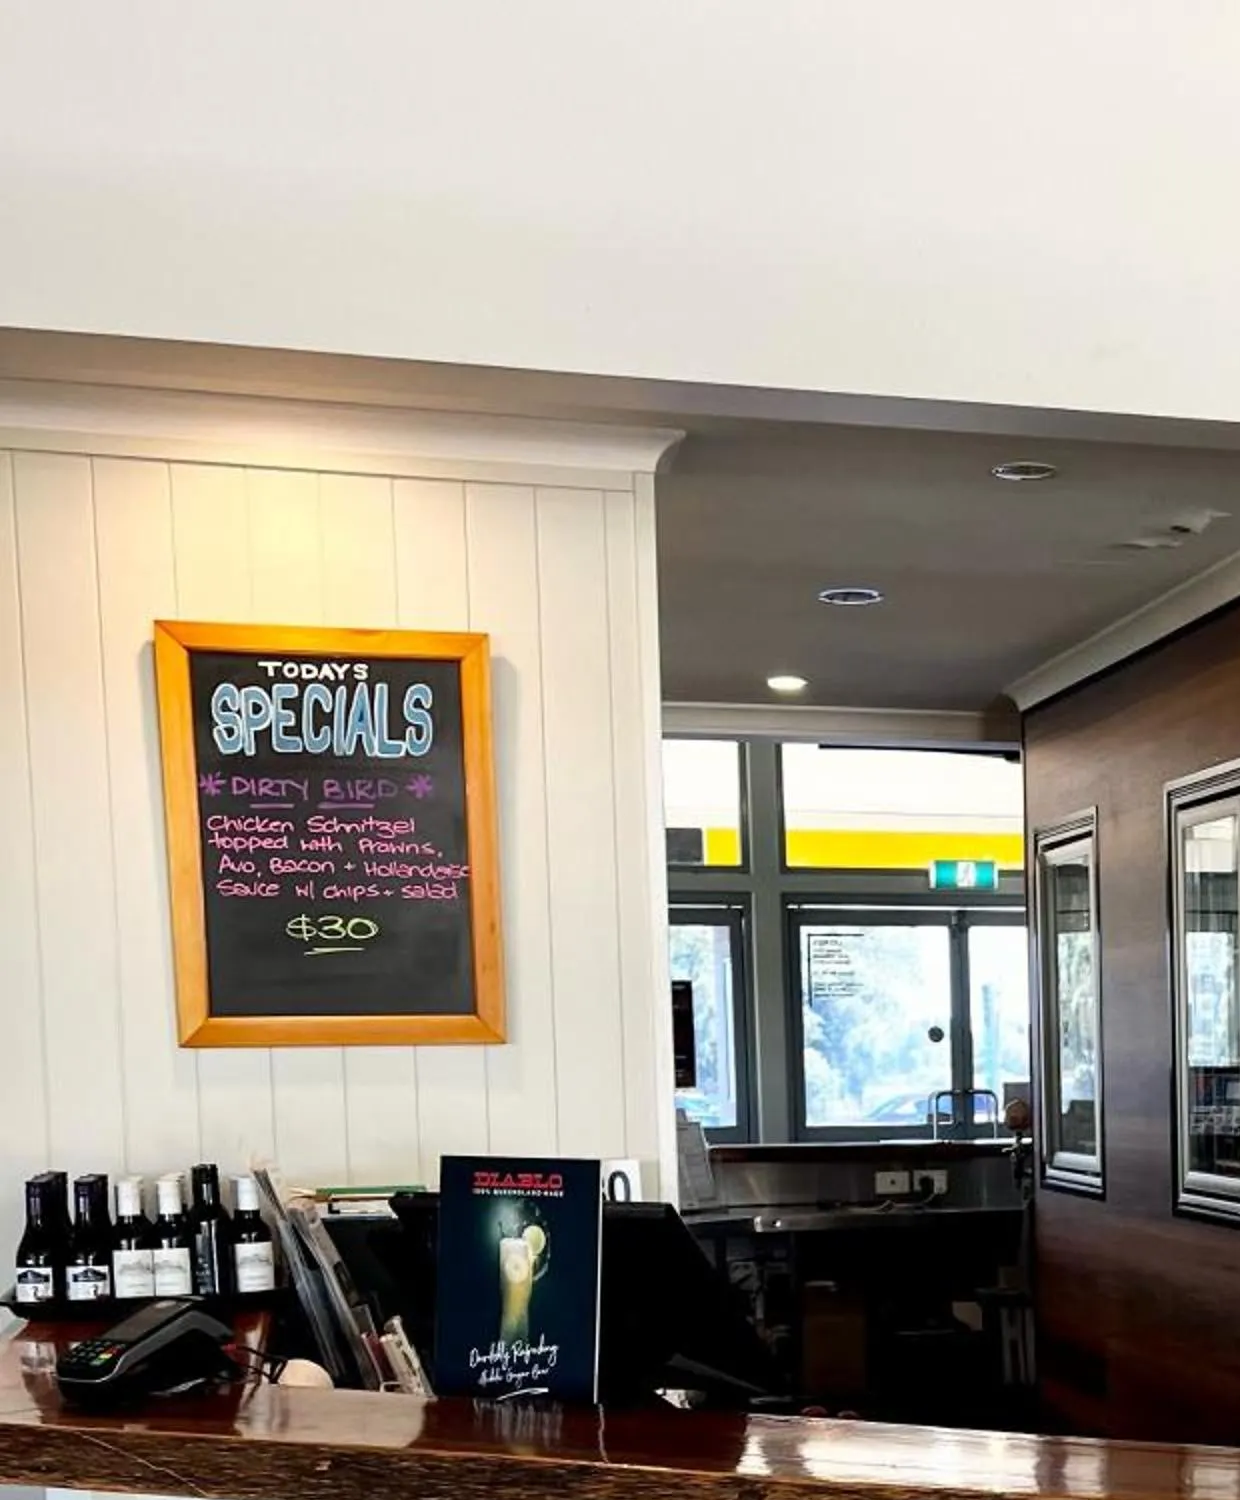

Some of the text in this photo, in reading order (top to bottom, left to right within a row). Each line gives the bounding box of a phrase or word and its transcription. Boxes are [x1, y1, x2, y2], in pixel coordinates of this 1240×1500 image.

[211, 682, 433, 758] SPECIALS
[231, 776, 398, 800] DIRTY BIRD
[207, 815, 415, 838] Chicken Schnitzel
[208, 834, 288, 850] topped
[300, 837, 342, 852] with
[218, 854, 261, 877] Avo,
[270, 857, 335, 874] Bacon
[216, 879, 280, 897] Sauce
[323, 882, 380, 902] chips
[401, 881, 458, 899] salad
[286, 913, 379, 941] $30
[473, 1171, 563, 1189] DIABLO
